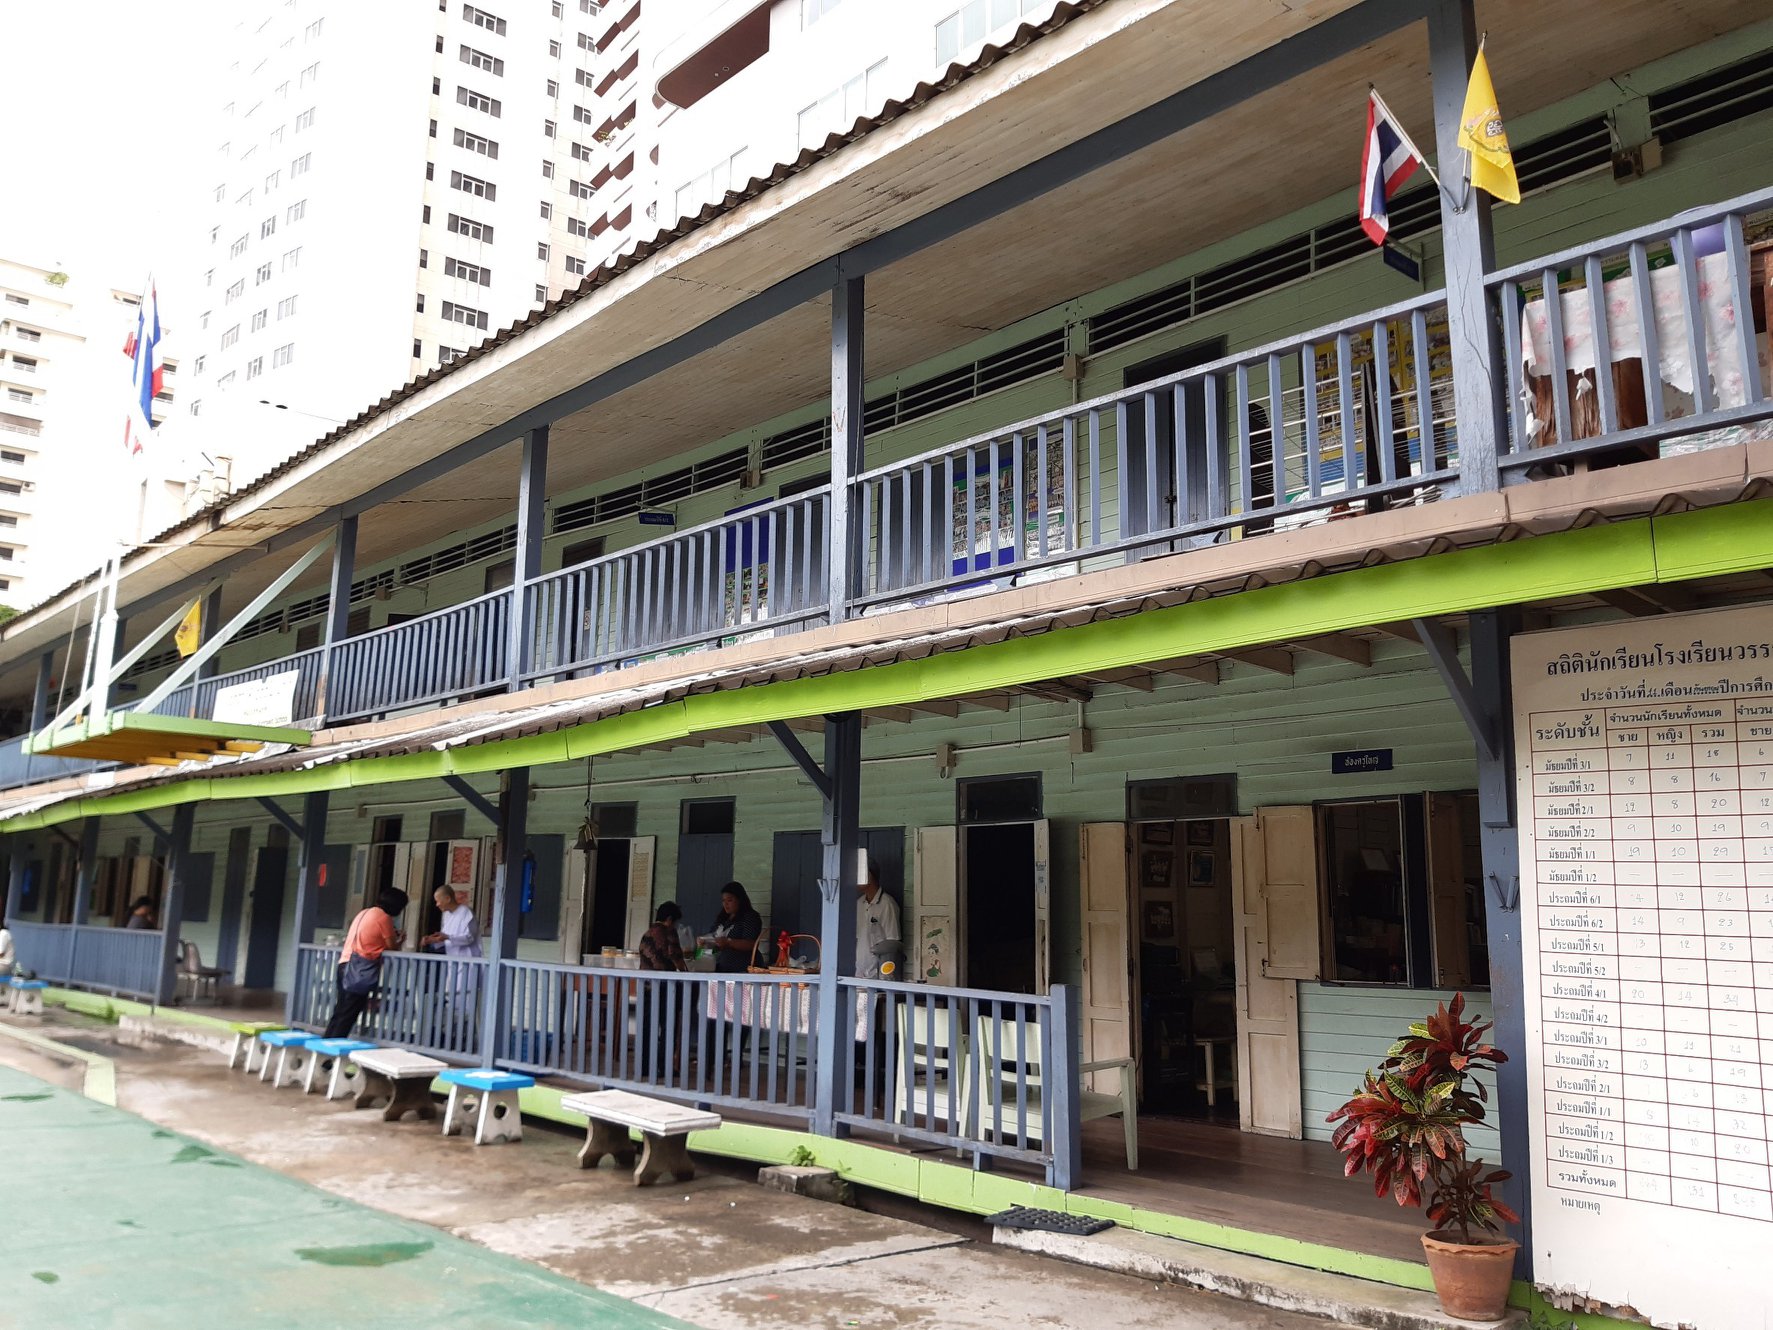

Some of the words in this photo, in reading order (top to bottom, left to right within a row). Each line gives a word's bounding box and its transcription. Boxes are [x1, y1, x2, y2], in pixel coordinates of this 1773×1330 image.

[1546, 639, 1773, 675] สถิตินักเรียนโรงเรียนวรร
[1609, 704, 1722, 723] จำนวนนักเรียนทั้งหมด
[1535, 713, 1600, 741] ระดับชั้น
[1617, 732, 1638, 742] ชาย
[1656, 727, 1683, 744] หญิง
[1700, 728, 1725, 738] รวม
[1545, 753, 1578, 771] มัธยมปีที่
[1580, 761, 1591, 770] 3/1
[1549, 775, 1581, 793] มัธยมปีที่
[1583, 783, 1595, 793] 3/2
[1548, 798, 1581, 816] มัธยมปีที่
[1582, 805, 1594, 815] 2/1
[1548, 820, 1581, 838] มัธยมปีที่
[1584, 829, 1595, 838] 2/2
[1549, 842, 1583, 859] มัธยมปีที่
[1585, 851, 1596, 859] 1/1
[1549, 865, 1583, 882] มัธยมปีที่
[1585, 873, 1597, 882] 1/2
[1549, 887, 1588, 904] ประถมปีที่
[1590, 895, 1601, 904] 6/1
[1550, 910, 1589, 928] ประถมปีที่
[1591, 918, 1603, 929] 6/2
[1551, 934, 1591, 951] ประถมปีที่
[1593, 943, 1604, 952] 5/1
[1552, 958, 1592, 975] ประถมปีที่
[1594, 966, 1606, 976] 5/2
[1553, 980, 1593, 998] ประถมปีที่
[1595, 989, 1606, 999] 4/1
[1554, 1005, 1594, 1023] ประถมปีที่
[1596, 1014, 1608, 1024] 4/2
[1554, 1027, 1594, 1045] ประถมปีที่
[1596, 1036, 1608, 1046] 3/1
[1555, 1050, 1594, 1068] ประถมปีที่
[1597, 1059, 1609, 1070] 3/2
[1556, 1075, 1596, 1093] ประถมปีที่
[1598, 1084, 1610, 1094] 2/1
[1557, 1097, 1596, 1115] ประถมปีที่
[1599, 1107, 1611, 1117] 1/1
[1558, 1121, 1599, 1139] ประถมปีที่
[1601, 1131, 1613, 1141] 1/2
[1558, 1145, 1598, 1163] ประถมปีที่
[1601, 1154, 1613, 1165] 1/3
[1558, 1169, 1617, 1188] รวมทั้งหมด
[1560, 1196, 1601, 1215] หมายเหตุ
